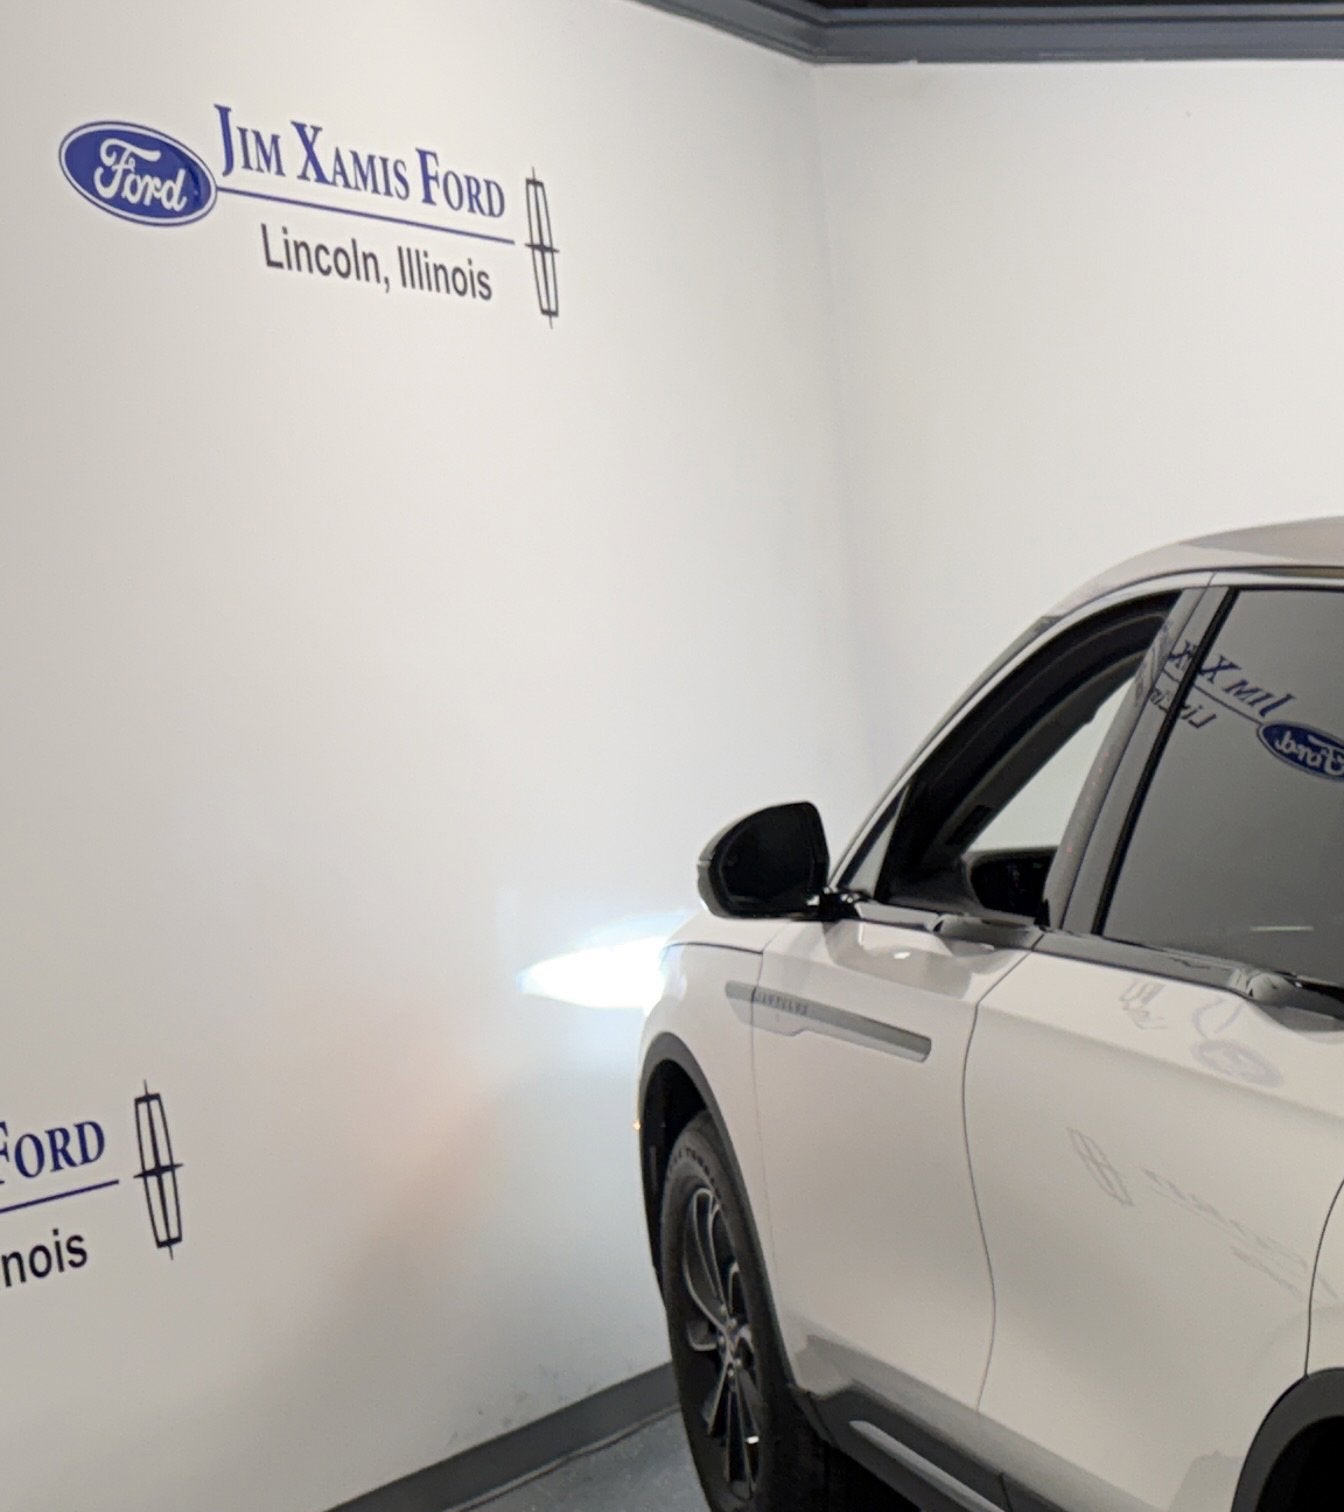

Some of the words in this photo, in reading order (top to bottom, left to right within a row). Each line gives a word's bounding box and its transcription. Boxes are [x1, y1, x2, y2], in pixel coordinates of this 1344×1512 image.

[93, 137, 189, 213] Ford
[213, 104, 286, 178] JIM
[291, 121, 410, 200] XAMIS
[414, 147, 507, 220] FORD
[260, 223, 392, 294] Lincoln,
[397, 244, 494, 301] Illinois
